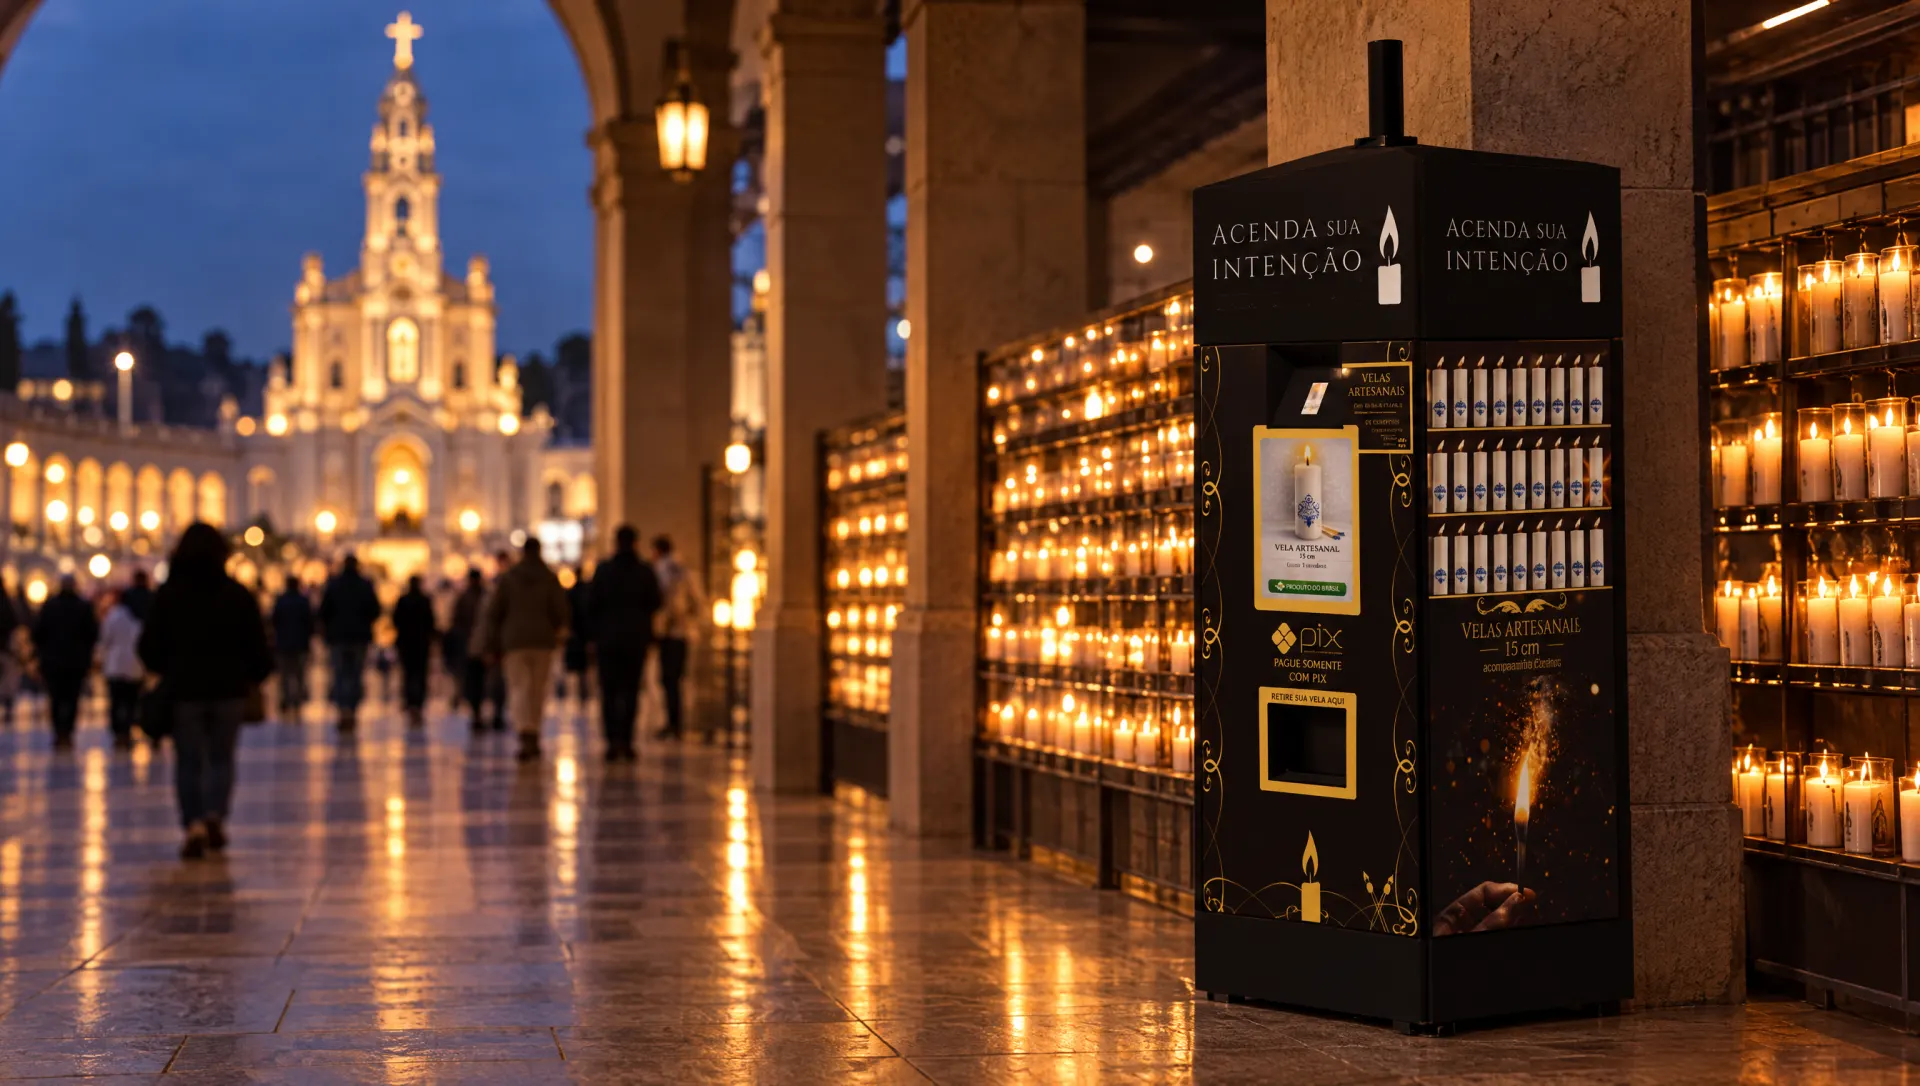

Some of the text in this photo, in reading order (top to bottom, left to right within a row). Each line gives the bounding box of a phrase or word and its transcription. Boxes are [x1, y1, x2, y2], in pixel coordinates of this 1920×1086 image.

[1212, 217, 1361, 246] ACENDA SUA
[1446, 217, 1567, 240] ACENDA SUA
[1212, 246, 1362, 280] INTENÇÃO
[1446, 247, 1568, 276] INTENÇÃO
[1361, 372, 1391, 383] VELAS
[1347, 386, 1405, 397] ARTESANAIS
[1274, 543, 1340, 553] VELA ARTESANAL
[1300, 623, 1343, 654] pix
[1461, 621, 1502, 639] VELAS
[1505, 640, 1540, 657] 15 cm
[1273, 658, 1342, 671] PAGUE SOMENTE
[1289, 672, 1327, 684] COM PIX
[1271, 692, 1345, 706] RETIRE SUA VELA AQUI
